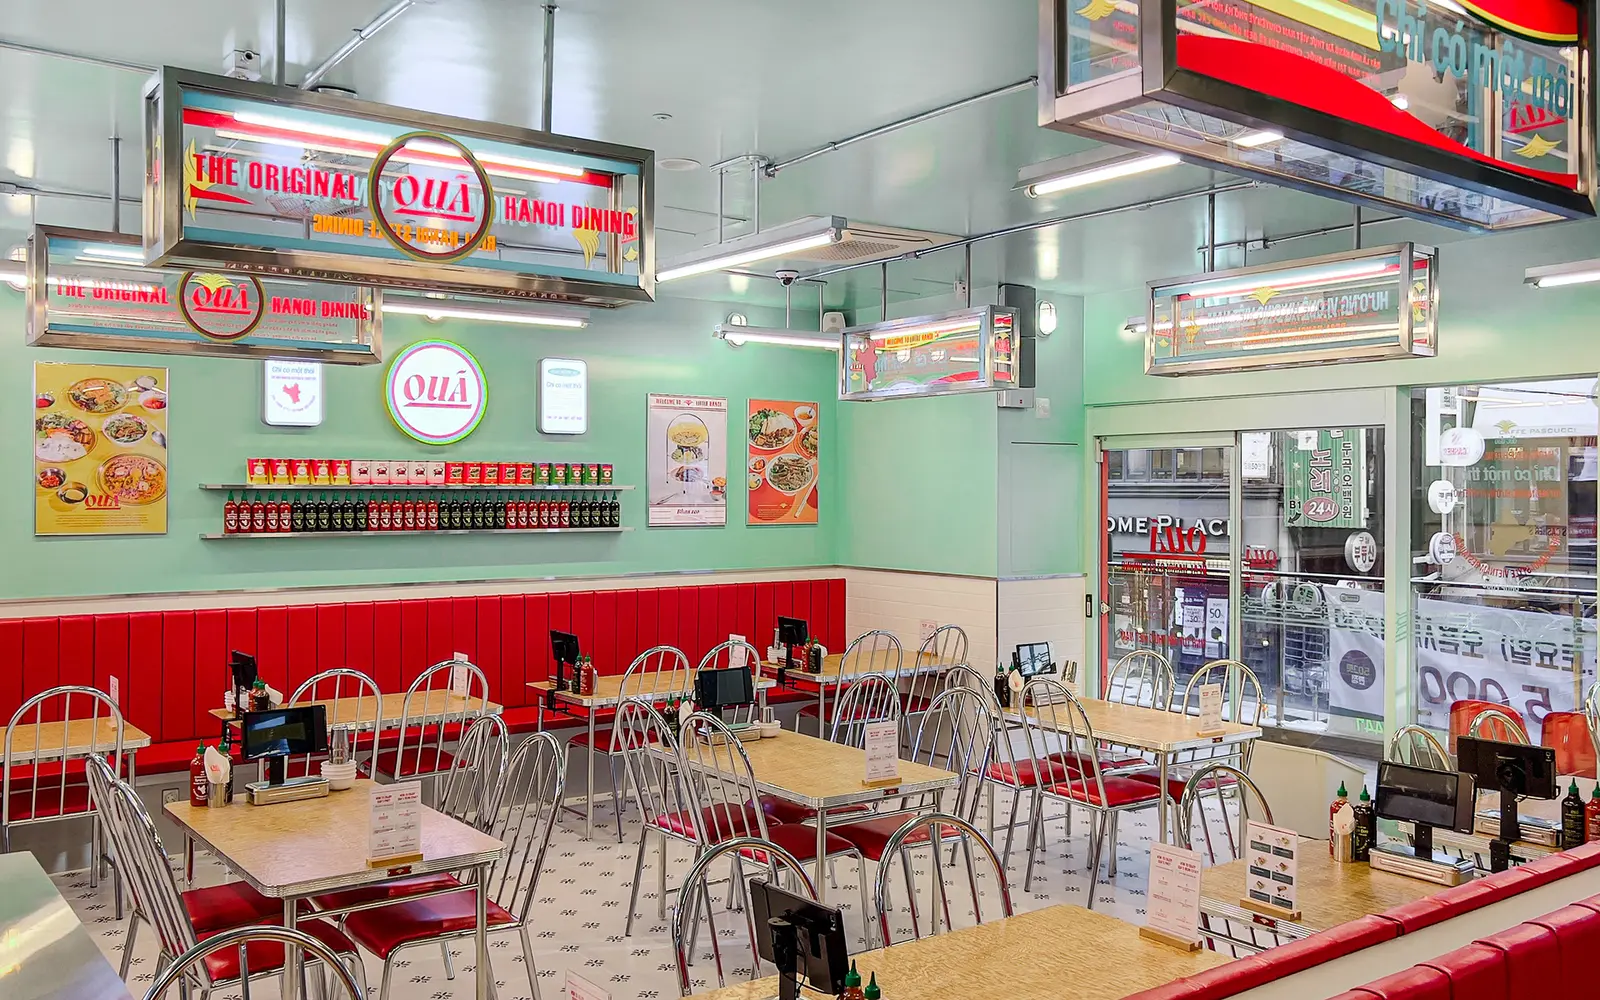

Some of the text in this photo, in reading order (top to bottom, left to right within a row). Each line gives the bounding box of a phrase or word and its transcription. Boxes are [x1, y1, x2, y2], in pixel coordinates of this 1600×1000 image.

[1431, 20, 1467, 80] có
[193, 153, 239, 187] THE
[248, 161, 359, 201] ORIGINAL
[504, 196, 565, 227] HANOI
[571, 204, 635, 237] DINING
[271, 295, 318, 317] HANOI
[320, 301, 370, 321] DINING
[1529, 427, 1577, 435] PASCUCCI
[1307, 501, 1336, 515] 24시
